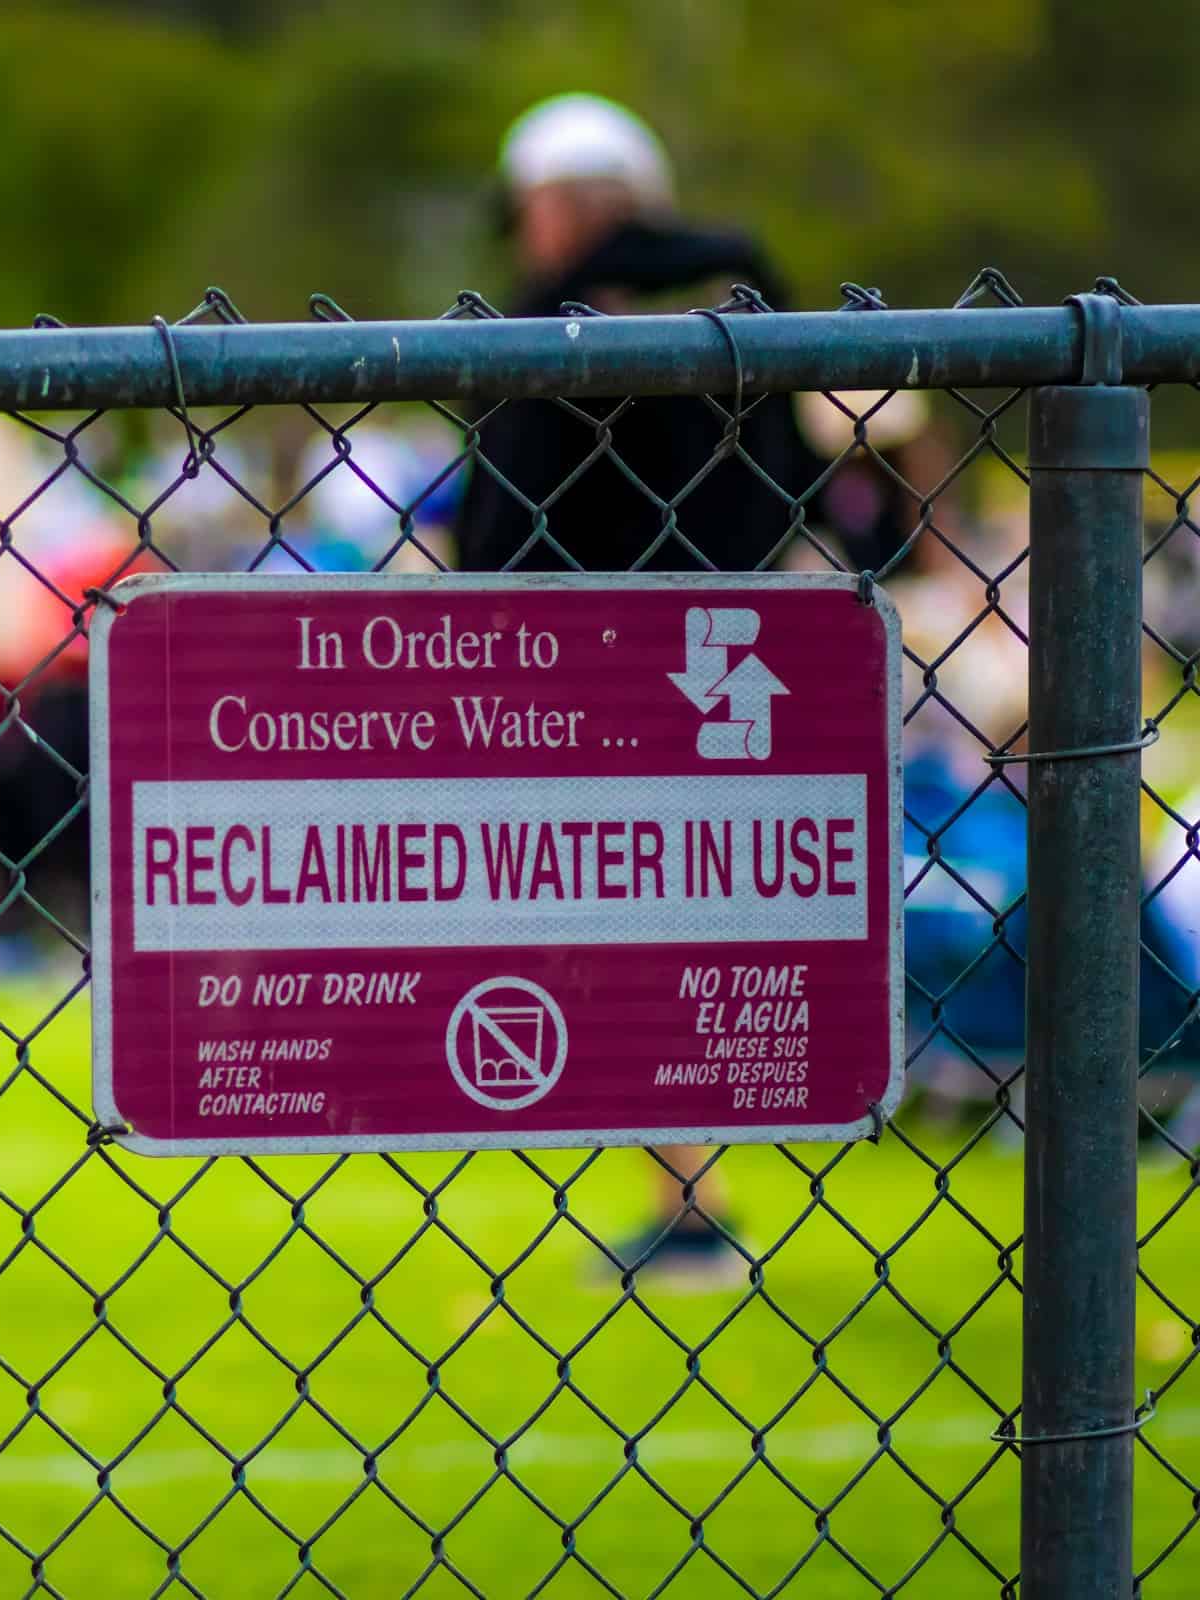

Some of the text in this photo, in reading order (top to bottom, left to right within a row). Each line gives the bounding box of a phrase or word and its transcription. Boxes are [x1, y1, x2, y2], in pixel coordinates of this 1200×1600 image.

[295, 614, 559, 670] In Order to
[209, 695, 639, 753] Conserve Water ...
[145, 817, 857, 907] RECLAIMED WATER IN USE
[198, 971, 422, 1008] DO NOT DRINK
[679, 964, 809, 999] NO TOME
[695, 1000, 809, 1034] EL AGUA
[197, 1038, 333, 1062] WASH HANDS
[704, 1035, 809, 1060] LAVESE SUS
[198, 1066, 262, 1089] AFTER
[654, 1060, 809, 1086] MANOS DESPUES
[198, 1091, 326, 1117] CONTACTING
[733, 1086, 809, 1109] DE USAR
